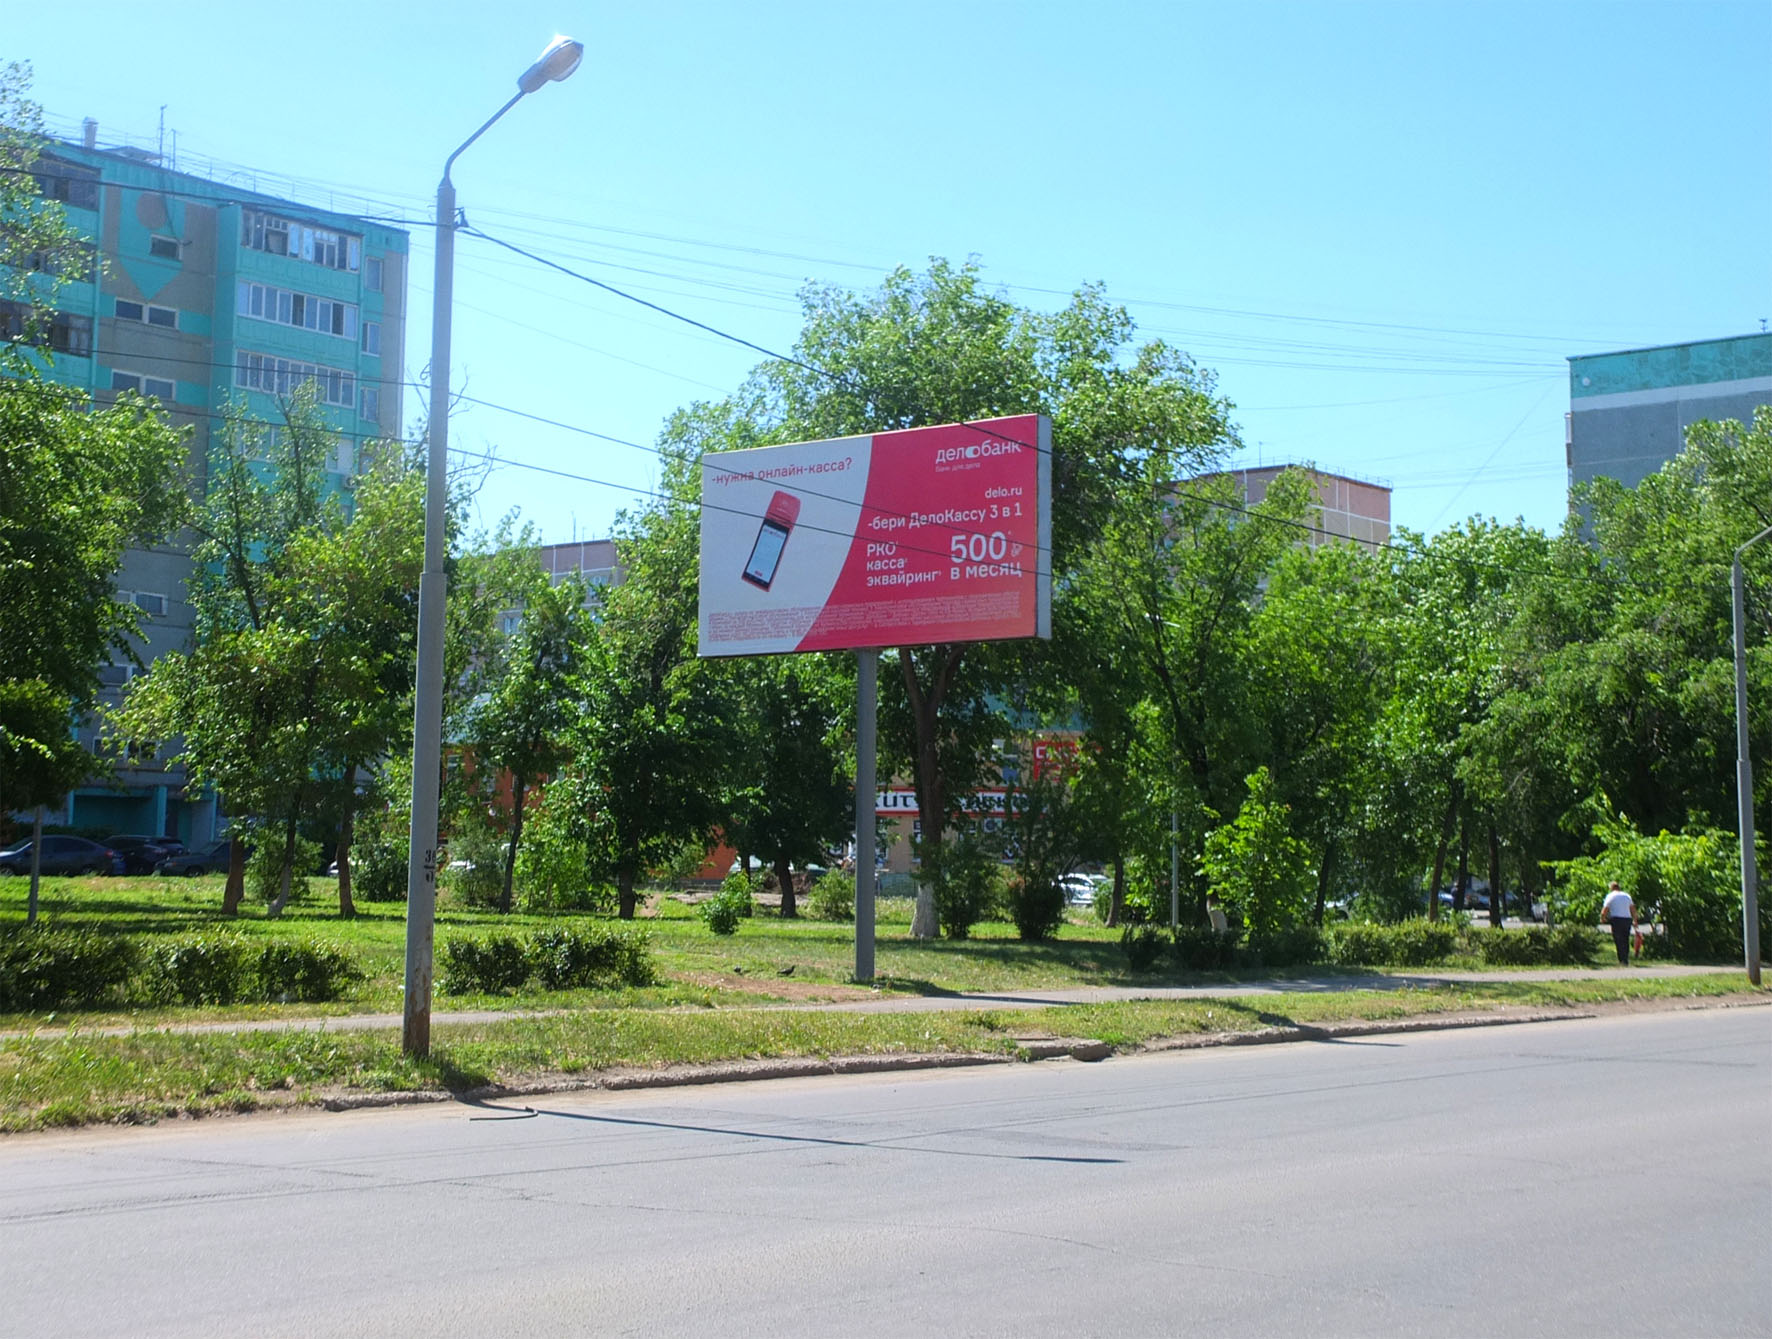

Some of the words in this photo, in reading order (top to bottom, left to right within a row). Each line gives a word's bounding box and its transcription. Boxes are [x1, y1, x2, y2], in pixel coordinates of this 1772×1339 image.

[712, 471, 754, 486] -нужна
[758, 457, 852, 480] онлайн-касса?
[985, 487, 1022, 498] delo.ru
[868, 516, 905, 531] -бери
[909, 509, 986, 529] ДелоКассу
[990, 504, 998, 518] 3
[1002, 506, 1010, 517] в
[1015, 503, 1022, 516] 1
[951, 567, 960, 580] в
[965, 562, 1022, 578] месяц
